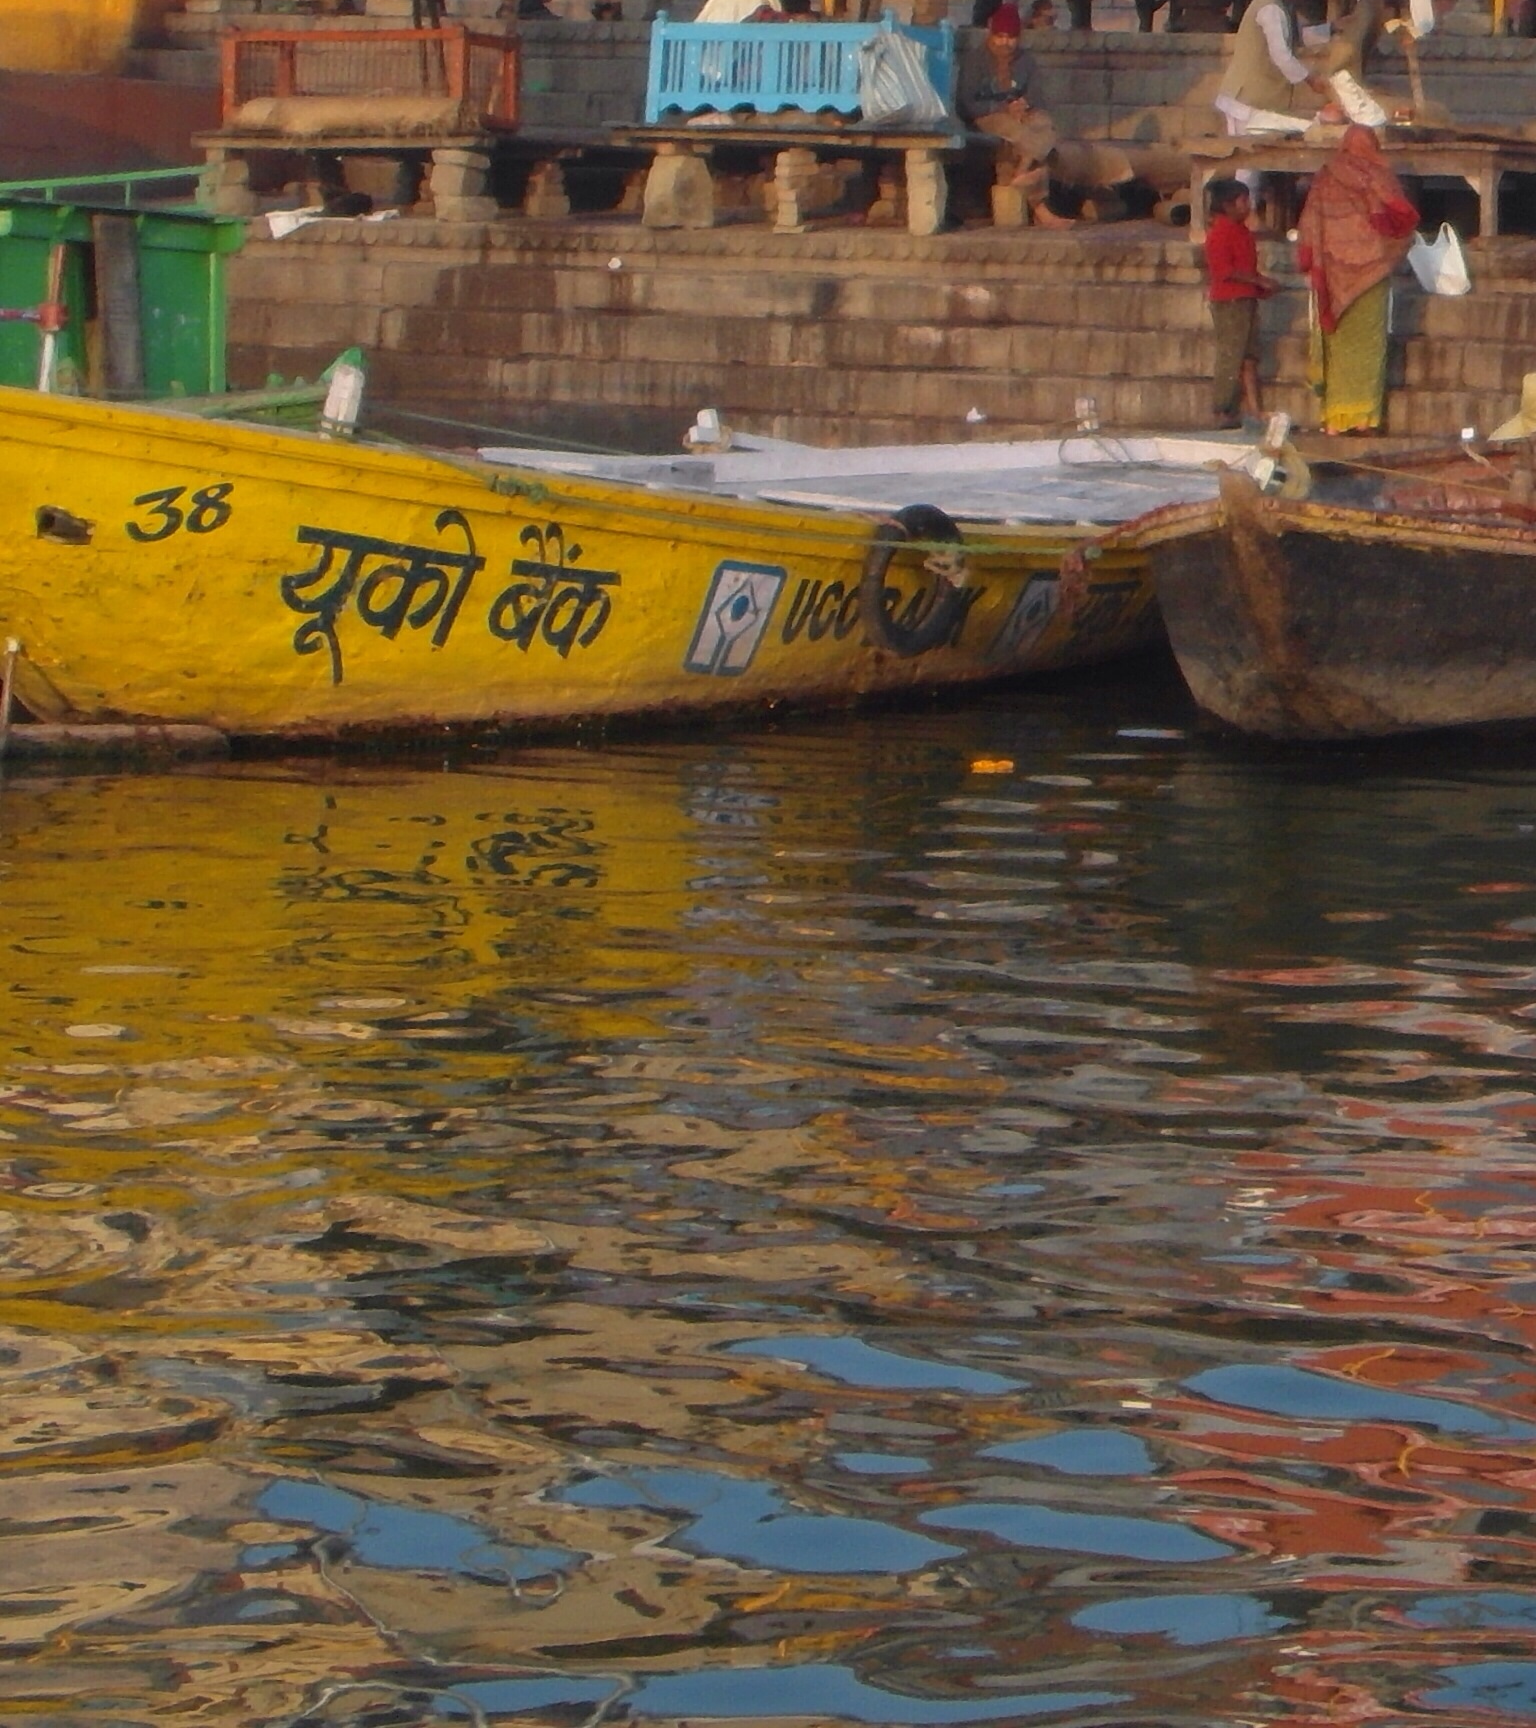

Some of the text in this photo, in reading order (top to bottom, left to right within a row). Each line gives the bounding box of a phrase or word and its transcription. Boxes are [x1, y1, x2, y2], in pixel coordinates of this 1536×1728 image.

[124, 482, 235, 543] 38
[280, 509, 622, 685] यूको बैंक
